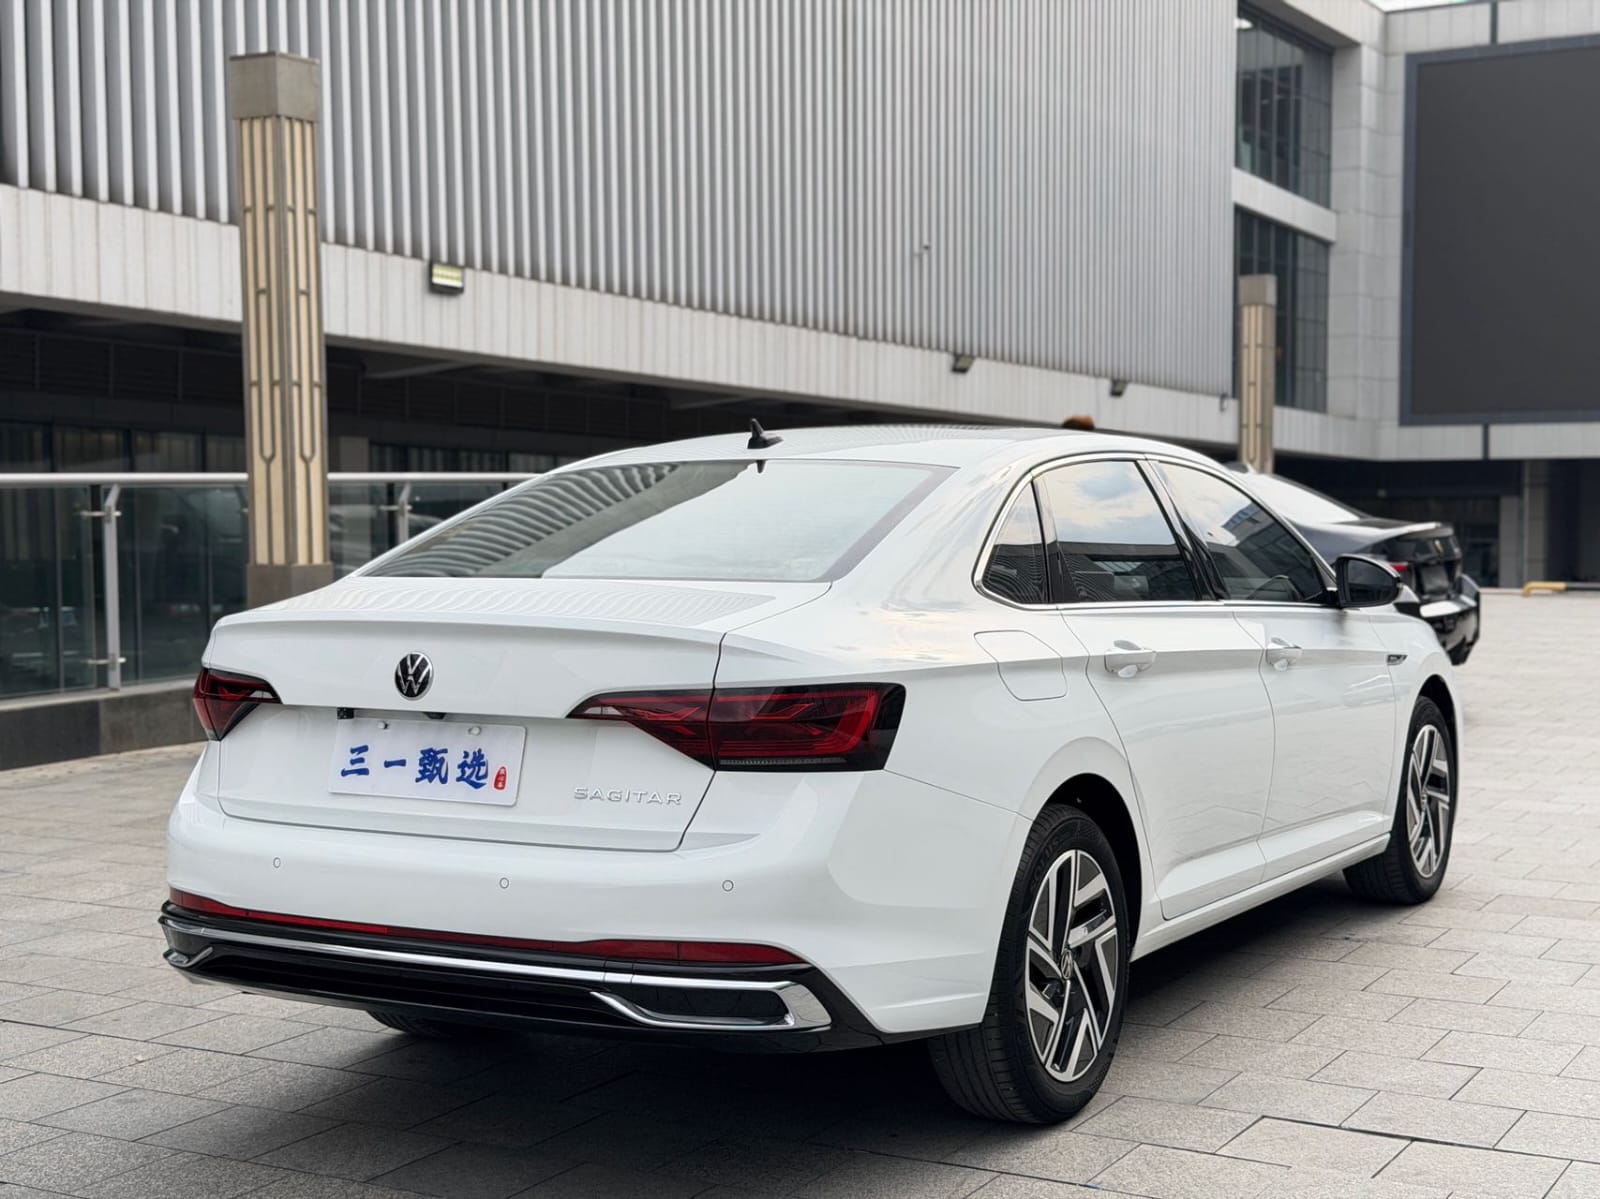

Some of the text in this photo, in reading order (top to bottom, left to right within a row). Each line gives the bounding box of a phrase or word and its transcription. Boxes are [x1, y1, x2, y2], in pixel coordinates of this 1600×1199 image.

[341, 745, 489, 789] 三一甄选
[574, 787, 682, 805] SAGITAR
